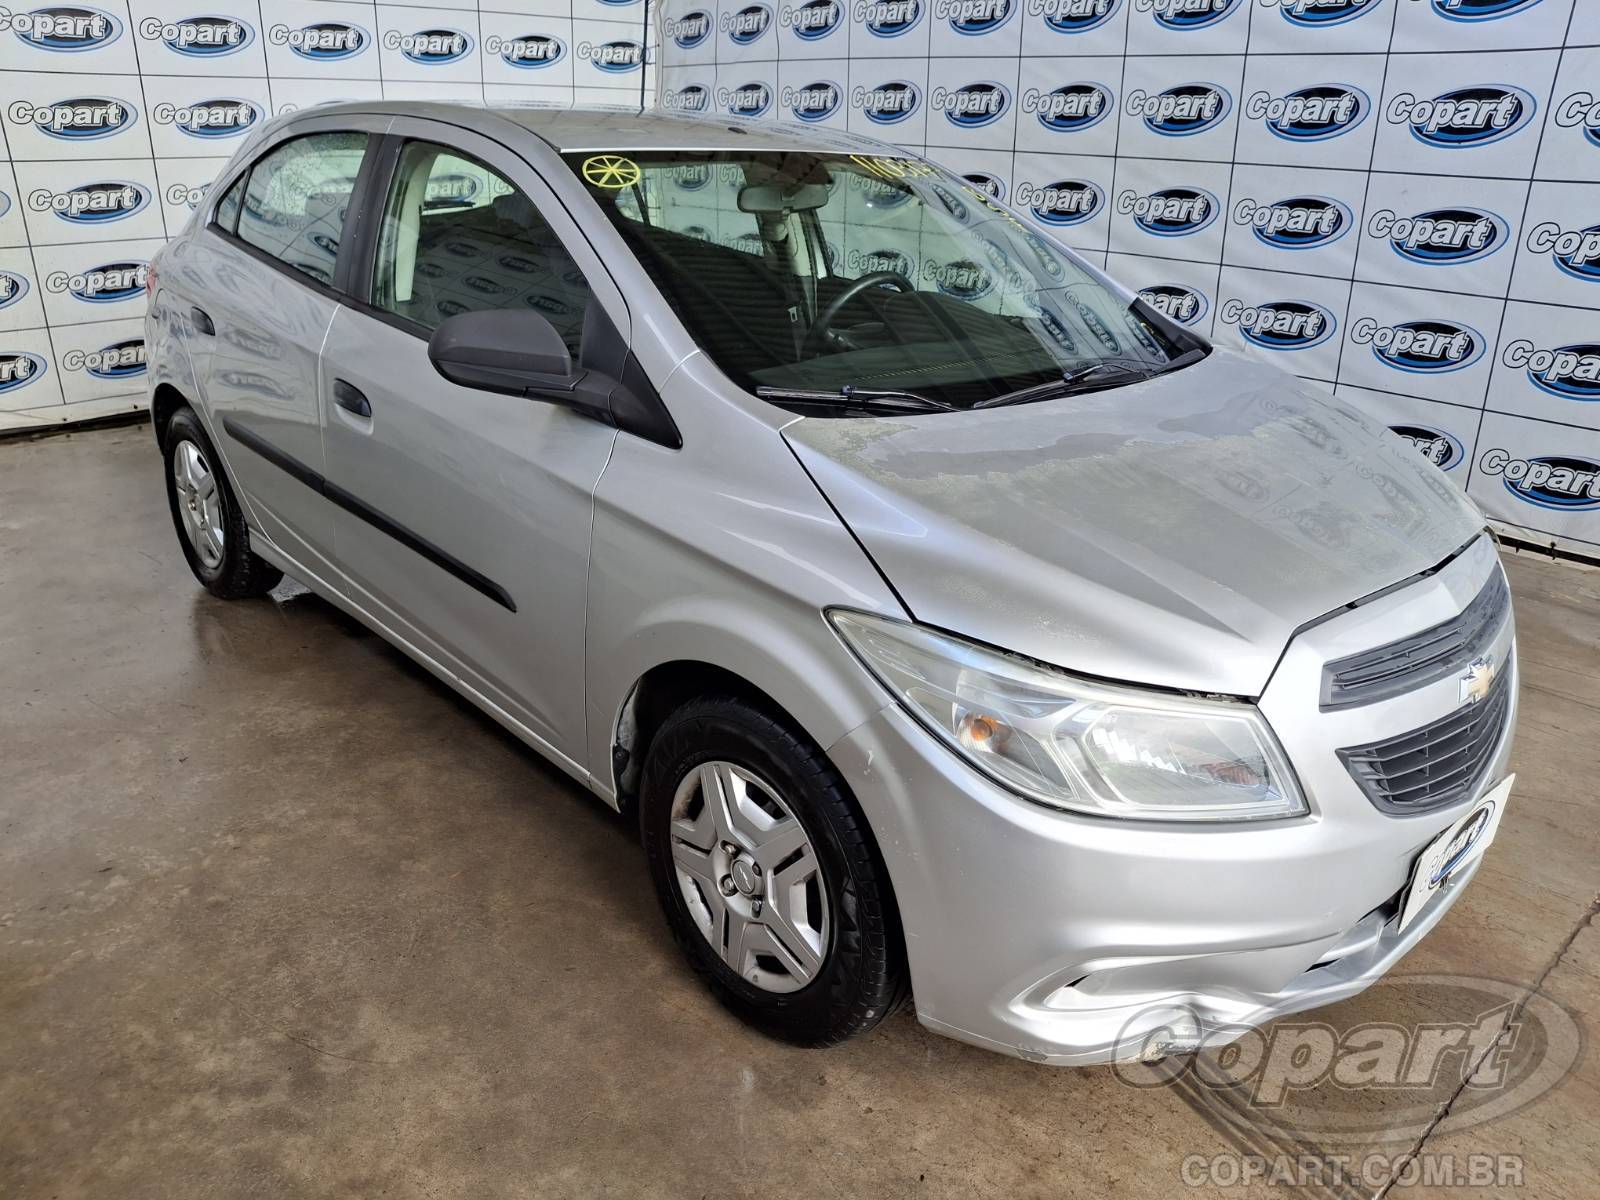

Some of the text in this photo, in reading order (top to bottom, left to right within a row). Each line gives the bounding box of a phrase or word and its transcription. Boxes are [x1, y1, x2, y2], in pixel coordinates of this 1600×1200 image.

[719, 8, 769, 37] Copart
[779, 3, 838, 31] Copart
[853, 0, 917, 29] Copart
[935, 0, 1006, 26] Copart
[140, 17, 242, 47] Copart
[269, 24, 360, 54] Copart
[383, 30, 464, 54] Copart
[664, 15, 709, 42] Copart
[485, 35, 559, 60] Copart
[576, 41, 643, 65] Copart
[663, 88, 707, 110] Copart
[717, 86, 768, 113] Copart
[781, 85, 836, 113] Copart
[851, 85, 915, 117] Copart
[930, 86, 1001, 117] Copart
[1021, 88, 1102, 121] Copart
[1126, 89, 1219, 126] Copart
[1246, 91, 1355, 129] Copart
[1386, 92, 1518, 135] Copart
[8, 101, 123, 132] Copart
[153, 102, 251, 129] Copart
[28, 188, 136, 217] Copart
[1016, 182, 1096, 214] Copart
[1117, 189, 1208, 225] Copart
[1233, 198, 1338, 236] Copart
[1368, 209, 1492, 251] Copart
[1526, 221, 1600, 266] Cop
[46, 264, 149, 296] Copart
[1140, 291, 1196, 319] art
[1220, 299, 1324, 338] Copart
[1351, 317, 1471, 360] Copart
[62, 344, 148, 373] Copar
[1502, 339, 1600, 383] Copa
